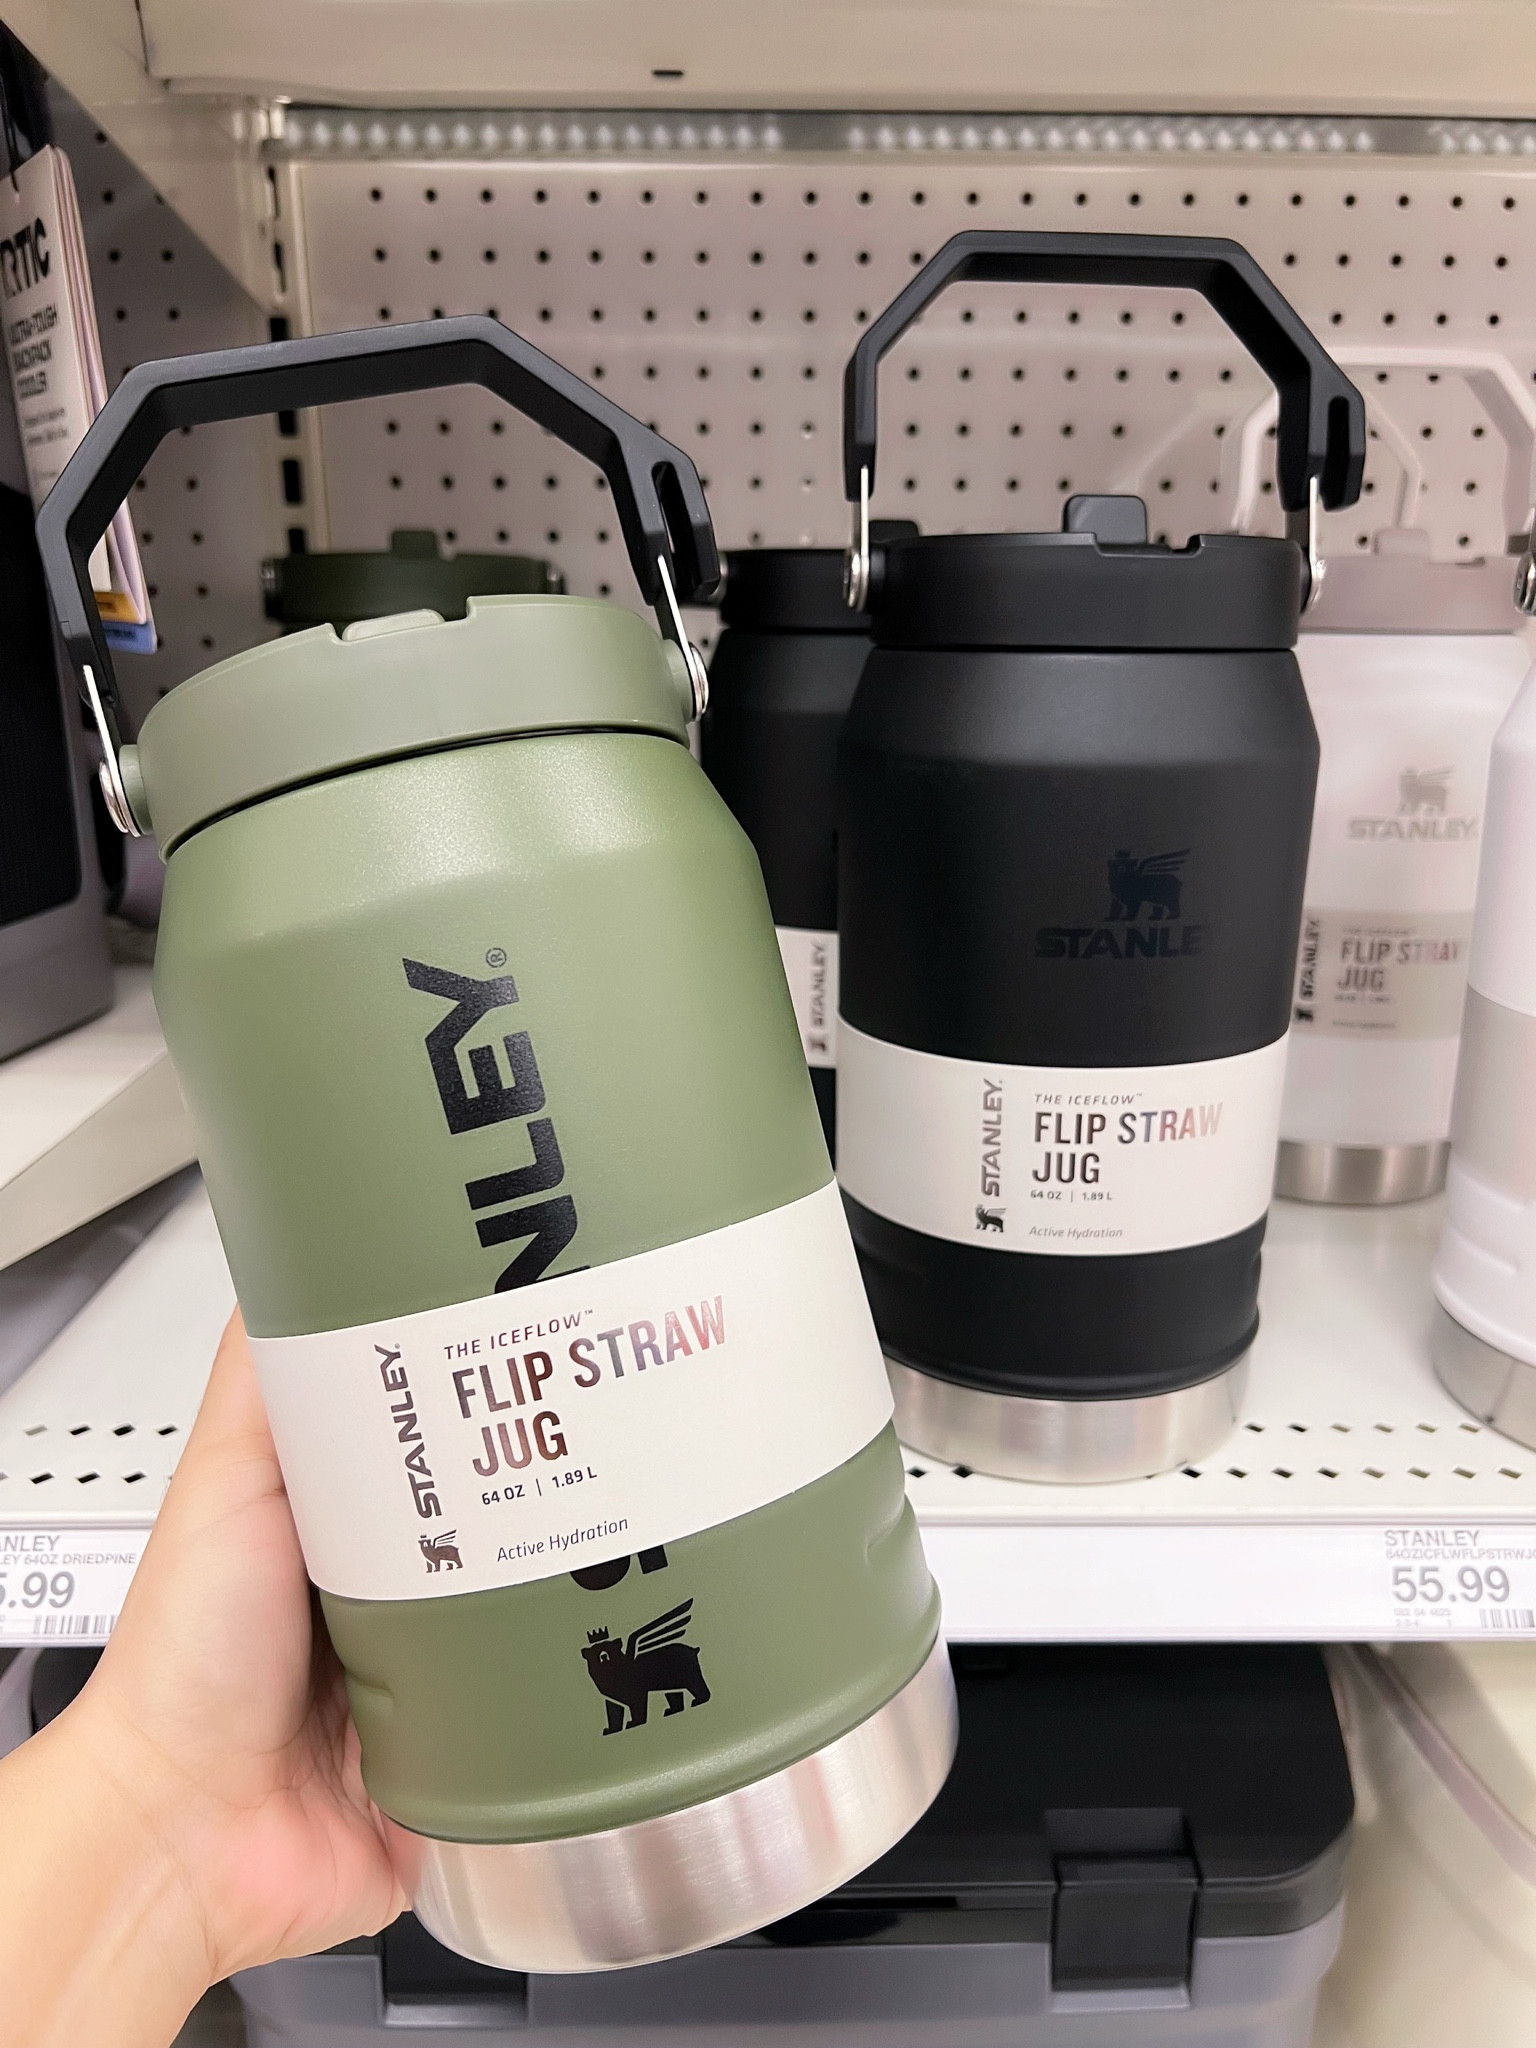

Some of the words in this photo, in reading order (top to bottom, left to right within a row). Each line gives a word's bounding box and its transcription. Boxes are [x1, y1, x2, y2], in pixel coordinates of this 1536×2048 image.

[1348, 818, 1479, 839] STANLEY
[1034, 926, 1206, 960] STANLE
[1341, 939, 1391, 963] FLIP
[1337, 968, 1385, 991] JUG
[1034, 1093, 1062, 1105] THE
[1033, 1111, 1107, 1144] FLIP
[1116, 1102, 1223, 1144] STRAW
[980, 1078, 1003, 1197] STANLEY
[1031, 1151, 1100, 1184] JUG
[1030, 1190, 1044, 1199] 64
[1047, 1191, 1062, 1200] OZ
[1082, 1192, 1104, 1201] 1.89
[1106, 1192, 1112, 1201] L
[1029, 1226, 1065, 1238] Active
[1067, 1228, 1123, 1240] Hydration
[444, 1339, 481, 1360] THE
[452, 1350, 554, 1419] FLIP
[568, 1296, 726, 1388] STRAW
[374, 1344, 443, 1519] STANLEY
[472, 1410, 568, 1477] JUG
[481, 1490, 501, 1506] 64
[503, 1484, 525, 1500] OZ
[551, 1469, 584, 1488] 1.89
[587, 1466, 598, 1479] L
[0, 1535, 61, 1552] NLEY
[497, 1541, 545, 1563] Active
[549, 1518, 628, 1552] Hydration
[1384, 1529, 1480, 1547] STANLEY
[24, 1554, 59, 1565] 64OZ
[62, 1553, 137, 1565] DRIEDPINE
[1391, 1565, 1510, 1602] 55.99
